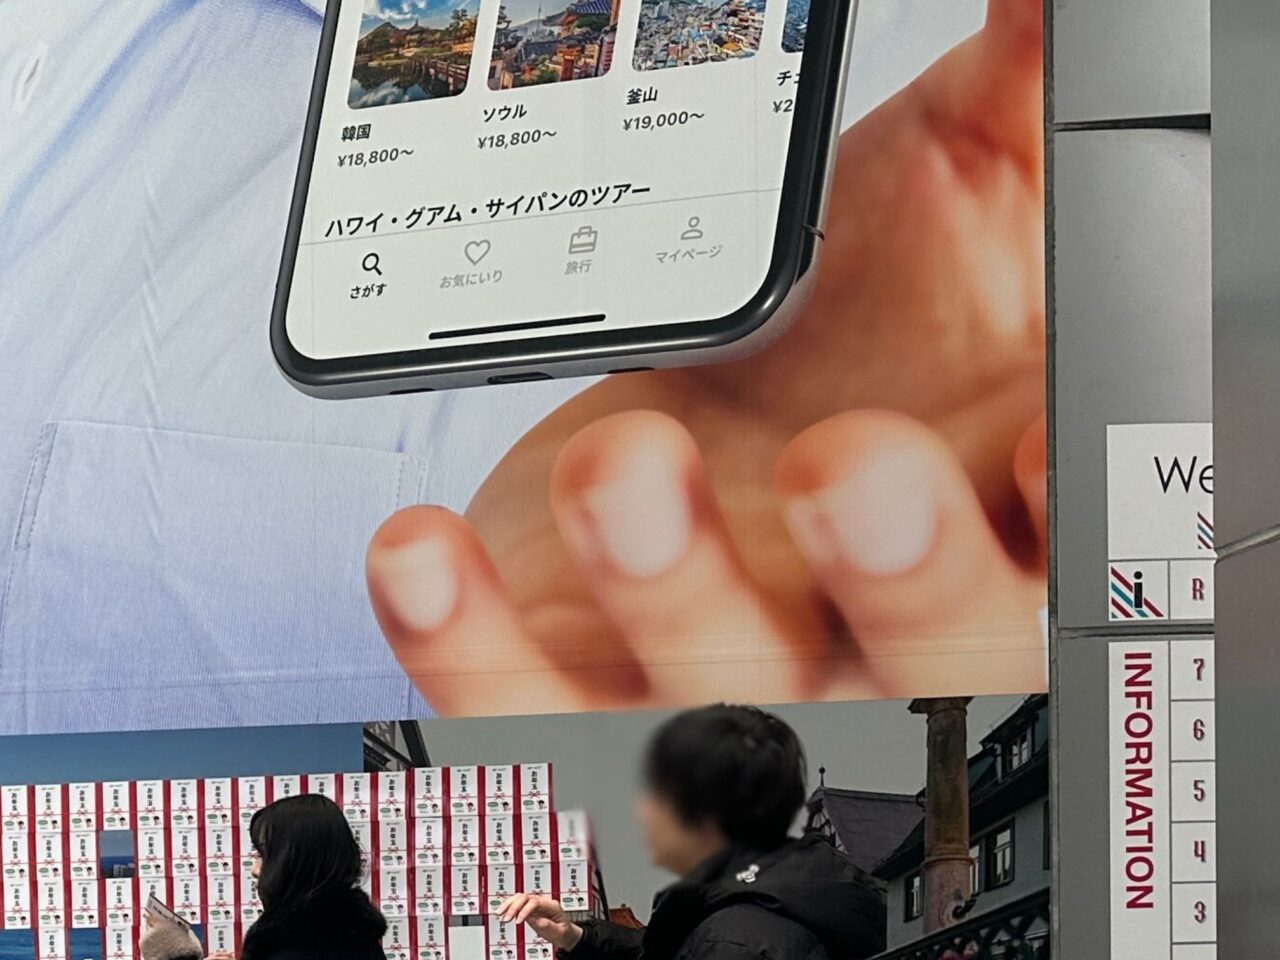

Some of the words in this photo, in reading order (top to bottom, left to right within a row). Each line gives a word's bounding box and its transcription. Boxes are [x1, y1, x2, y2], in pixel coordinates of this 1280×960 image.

[626, 86, 659, 105] 釜山
[482, 103, 528, 122] ソウル
[341, 123, 372, 142] 韓国
[324, 182, 651, 238] ハワイ・グアム・サイパンのツアー
[655, 244, 723, 265] マイページ
[565, 259, 593, 275] 旅行
[439, 269, 503, 290] お気にいり
[349, 281, 388, 300] さがす
[1192, 658, 1205, 681] 7
[1192, 718, 1206, 741] 6
[1124, 652, 1155, 910] INFORMATION
[1193, 780, 1206, 802] 5
[1193, 840, 1206, 863] 4
[1194, 901, 1207, 923] 3
